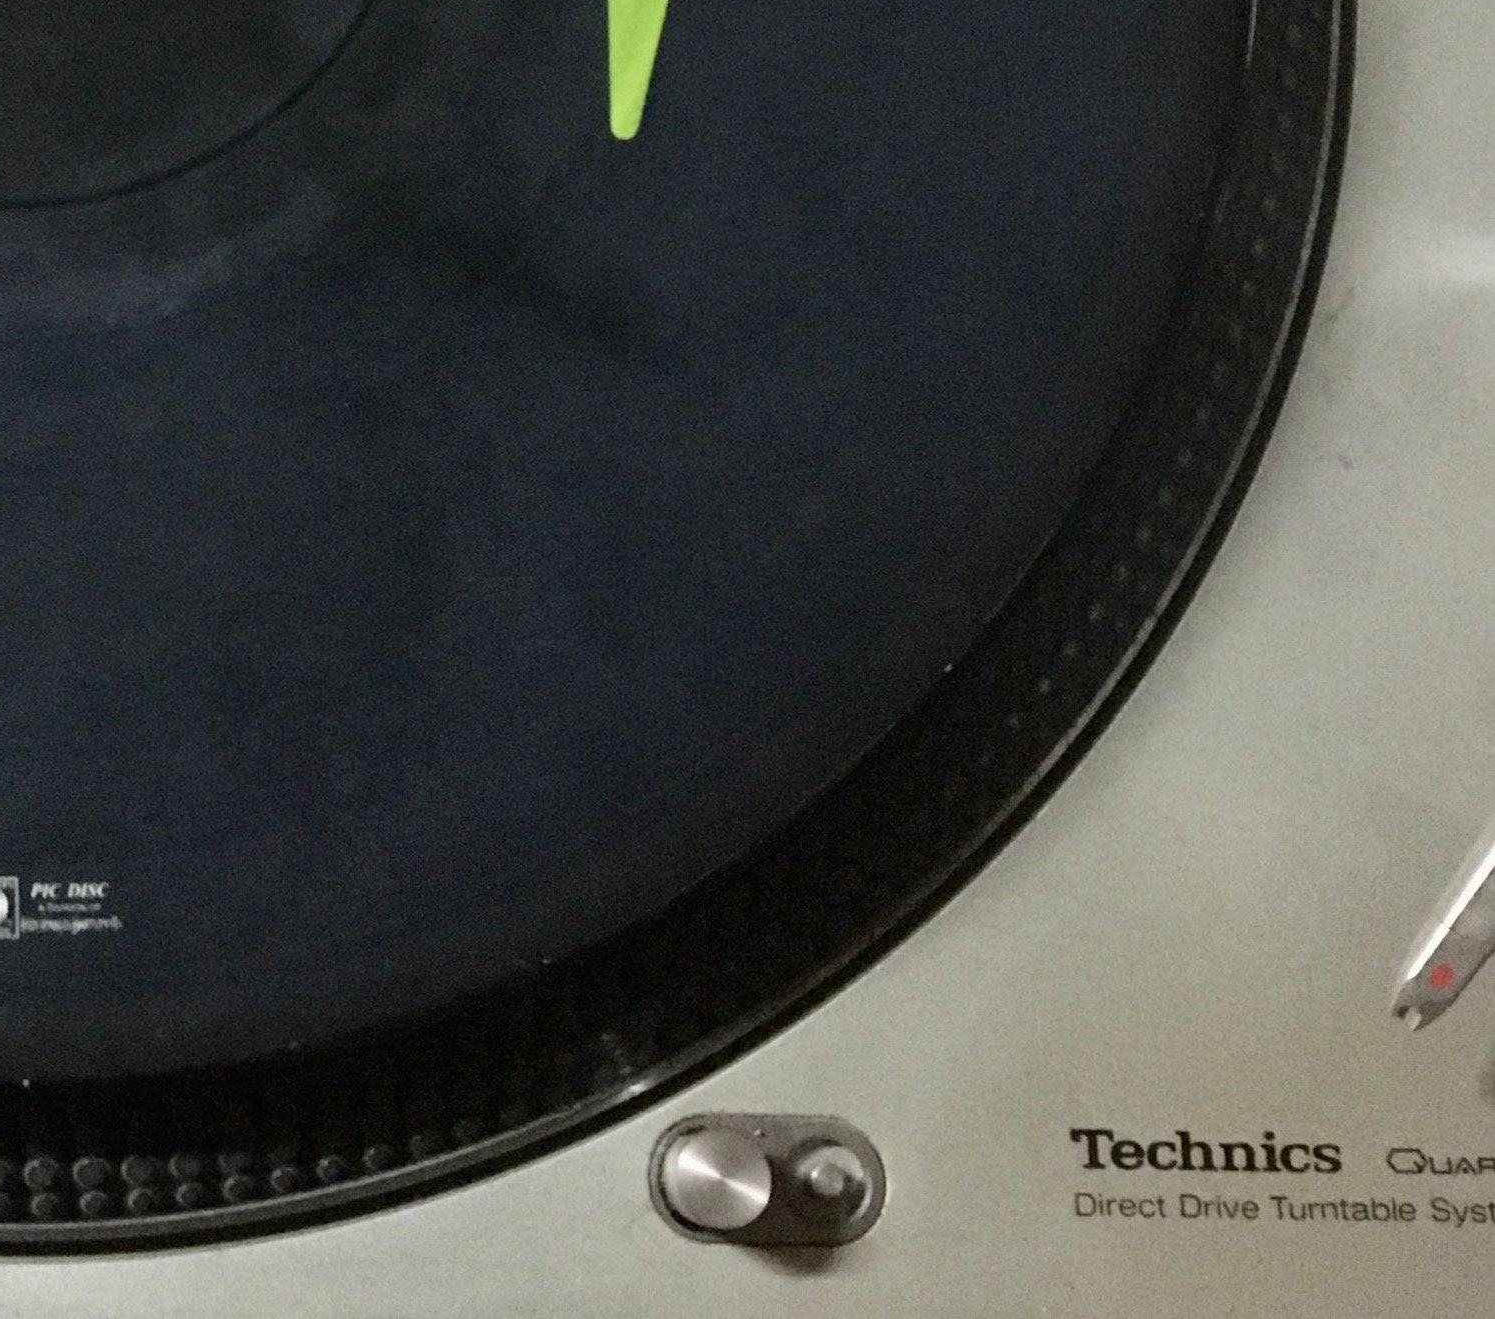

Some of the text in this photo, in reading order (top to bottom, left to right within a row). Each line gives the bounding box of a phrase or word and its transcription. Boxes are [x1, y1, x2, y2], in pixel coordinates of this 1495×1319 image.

[1069, 1127, 1343, 1174] Technics
[1073, 1192, 1165, 1218] Direct
[1178, 1193, 1260, 1220] Drive
[1270, 1195, 1418, 1223] Turntable
